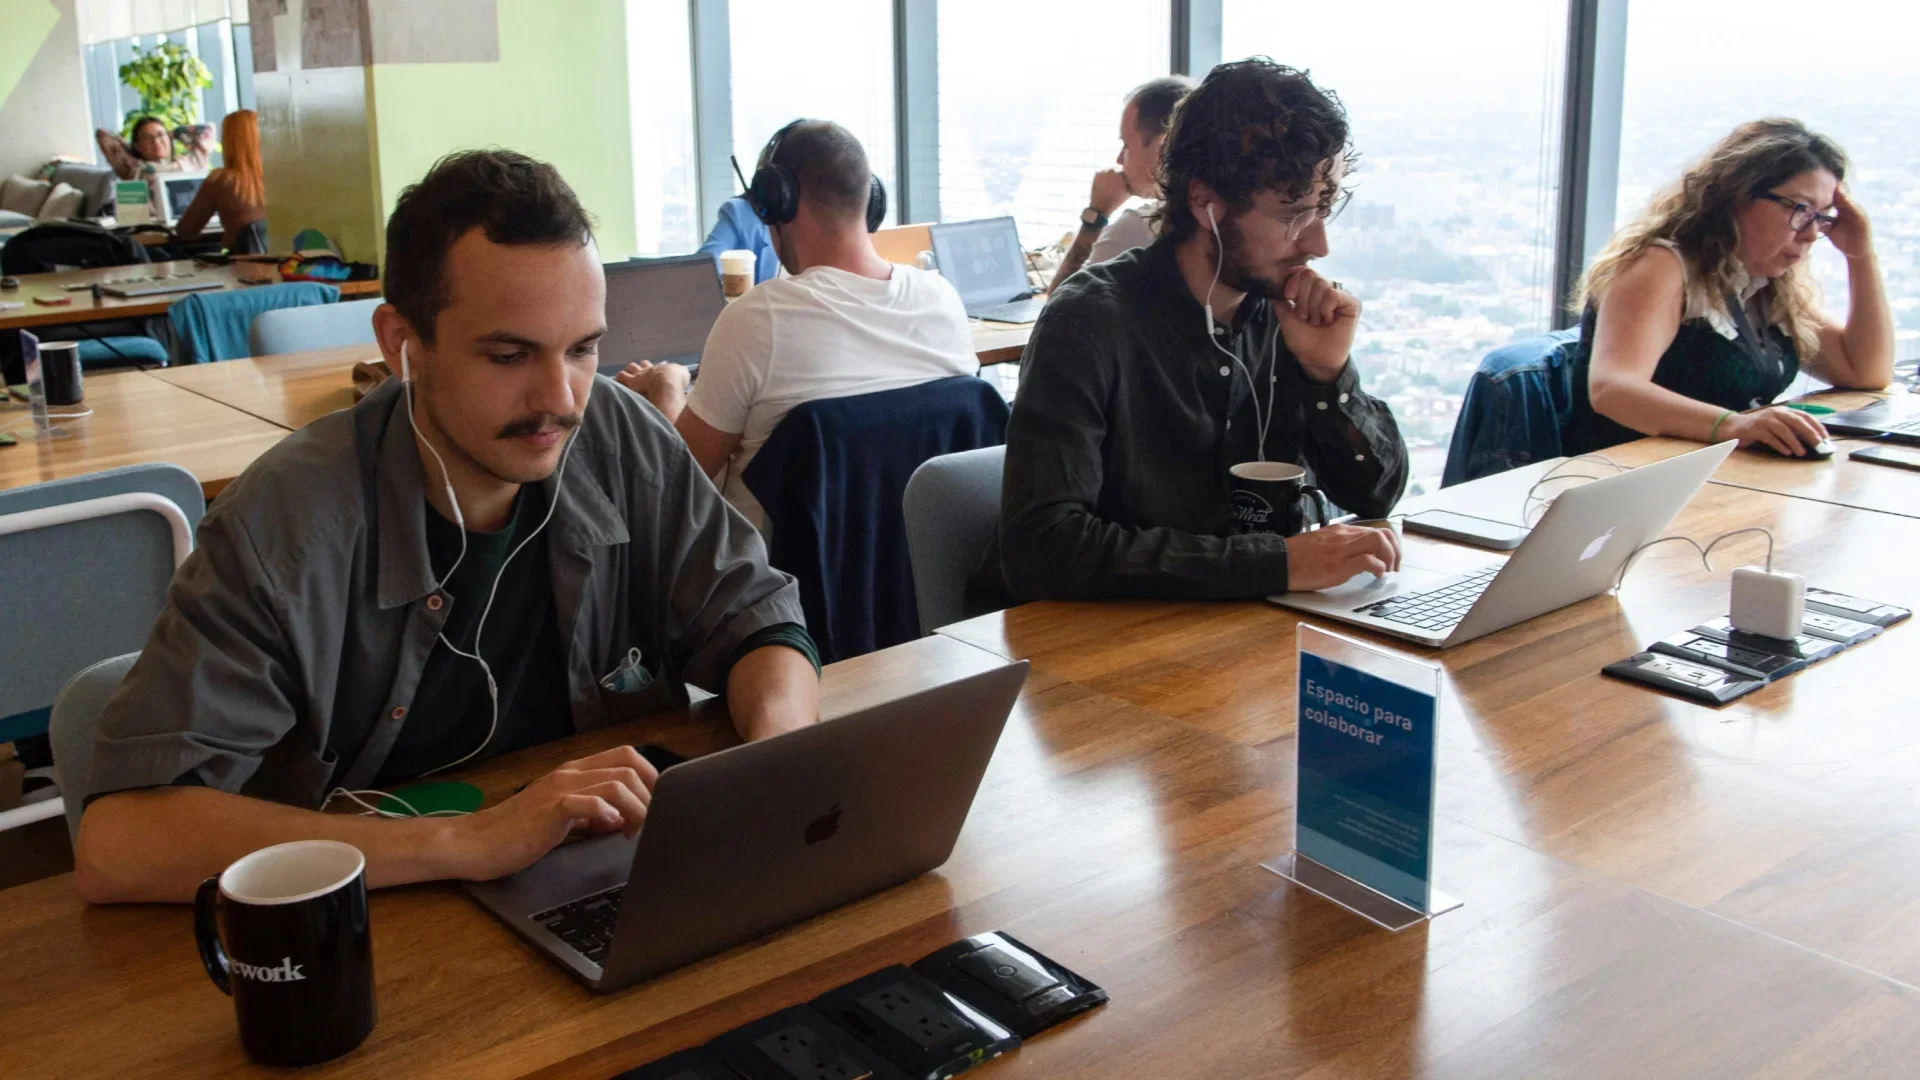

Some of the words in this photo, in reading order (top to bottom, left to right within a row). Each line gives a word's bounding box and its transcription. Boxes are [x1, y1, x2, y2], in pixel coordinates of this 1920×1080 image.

[1306, 679, 1370, 715] Espacio
[1373, 706, 1413, 732] para
[1304, 707, 1384, 746] colaborar
[230, 956, 307, 983] ework
